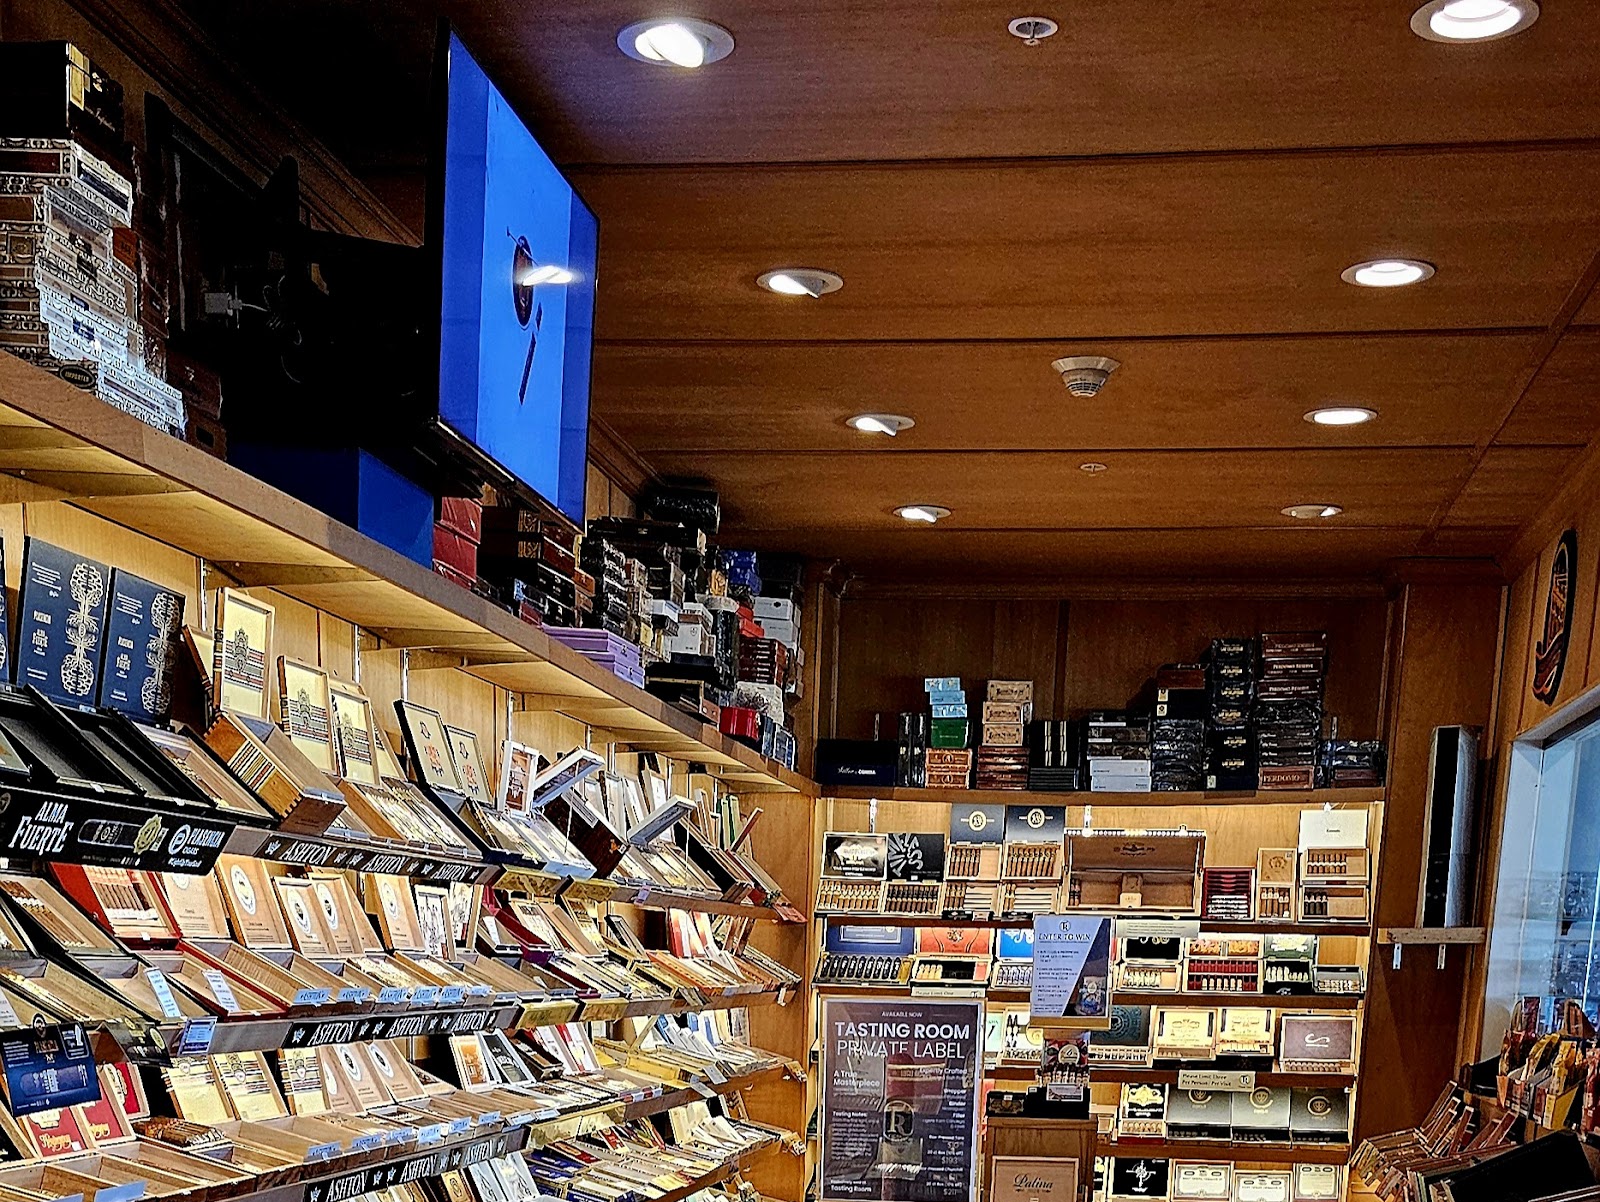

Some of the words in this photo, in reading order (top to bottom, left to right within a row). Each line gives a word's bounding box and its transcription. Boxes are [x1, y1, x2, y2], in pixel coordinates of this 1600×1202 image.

[1263, 774, 1300, 782] PERDOMO
[34, 800, 69, 824] ALMA
[8, 815, 75, 856] FUERTE
[187, 828, 225, 848] PLASENCIA
[279, 839, 337, 866] ASHTON
[361, 852, 408, 875] ASHTON
[430, 863, 473, 882] ASHTON
[1038, 933, 1062, 941] ENTER
[1064, 933, 1074, 941] TO
[1075, 933, 1091, 941] WIN
[307, 1021, 359, 1046] ASHTON
[385, 1015, 428, 1038] ASHTON
[452, 1011, 489, 1032] ASHTON
[835, 1022, 910, 1038] TASTING
[914, 1024, 970, 1040] ROOM
[837, 1040, 909, 1058] PRIVATE
[914, 1041, 965, 1059] LABEL
[833, 1078, 880, 1088] Masterpiece
[841, 1070, 858, 1078] True
[400, 1154, 437, 1183] ASHTON
[465, 1139, 493, 1166] ASHTON
[831, 1185, 853, 1193] Tasting
[854, 1185, 872, 1193] Room
